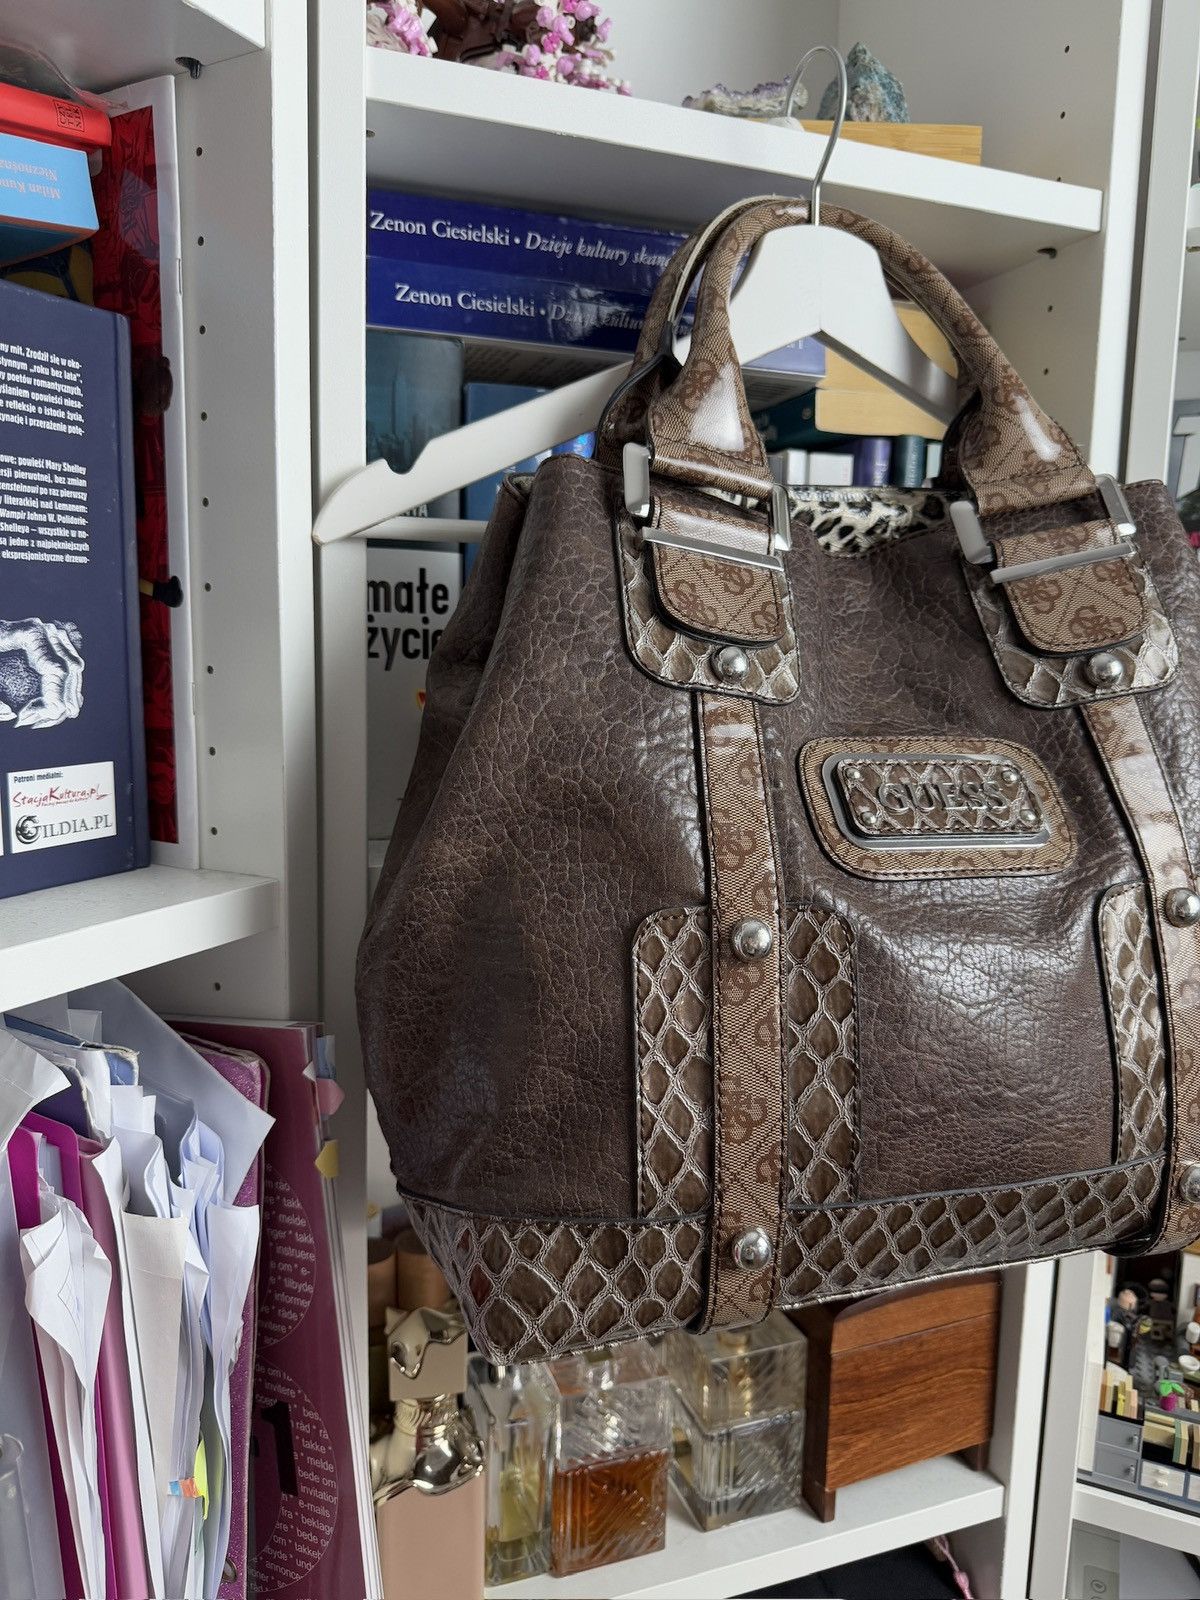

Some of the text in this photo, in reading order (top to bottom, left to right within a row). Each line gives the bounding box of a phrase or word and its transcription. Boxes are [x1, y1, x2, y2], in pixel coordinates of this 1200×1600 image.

[370, 210, 427, 236] Zenon
[431, 219, 510, 246] Ciesielski
[525, 231, 573, 259] Dzieje
[575, 236, 630, 267] kultury
[394, 282, 452, 308] Zenon
[457, 290, 536, 318] Ciesielski
[10, 345, 25, 357] mit.
[60, 357, 67, 366] w
[6, 372, 33, 385] poetów
[50, 367, 63, 379] bez
[31, 391, 63, 405] opowieści
[37, 406, 43, 414] o
[44, 406, 66, 419] istocie
[45, 459, 62, 472] Mary
[62, 462, 87, 475] Shelley
[54, 474, 66, 485] bez
[40, 486, 48, 496] po
[48, 487, 60, 497] raz
[40, 501, 54, 509] nad
[0, 508, 26, 520] Wampir
[27, 511, 47, 522] Johna
[47, 513, 57, 523] W.
[0, 522, 30, 534] Shelleya
[37, 527, 70, 537] wszystkie
[70, 529, 77, 538] w
[8, 536, 29, 546] jedne
[1, 550, 65, 562] ekspresjonistyczne
[367, 567, 449, 615] małe
[13, 770, 64, 783] Patroni medialni:
[877, 780, 1010, 815] GUESS
[15, 814, 113, 845] GILDIA.PL
[278, 1213, 307, 1228] melde
[276, 1245, 316, 1262] instruere
[284, 1278, 314, 1294] tilbyde
[264, 1382, 296, 1398] invitere
[302, 1437, 326, 1454] takke
[306, 1456, 334, 1473] melde
[297, 1466, 337, 1489] bede om
[298, 1498, 331, 1518] e-mails
[296, 1527, 319, 1544] bede
